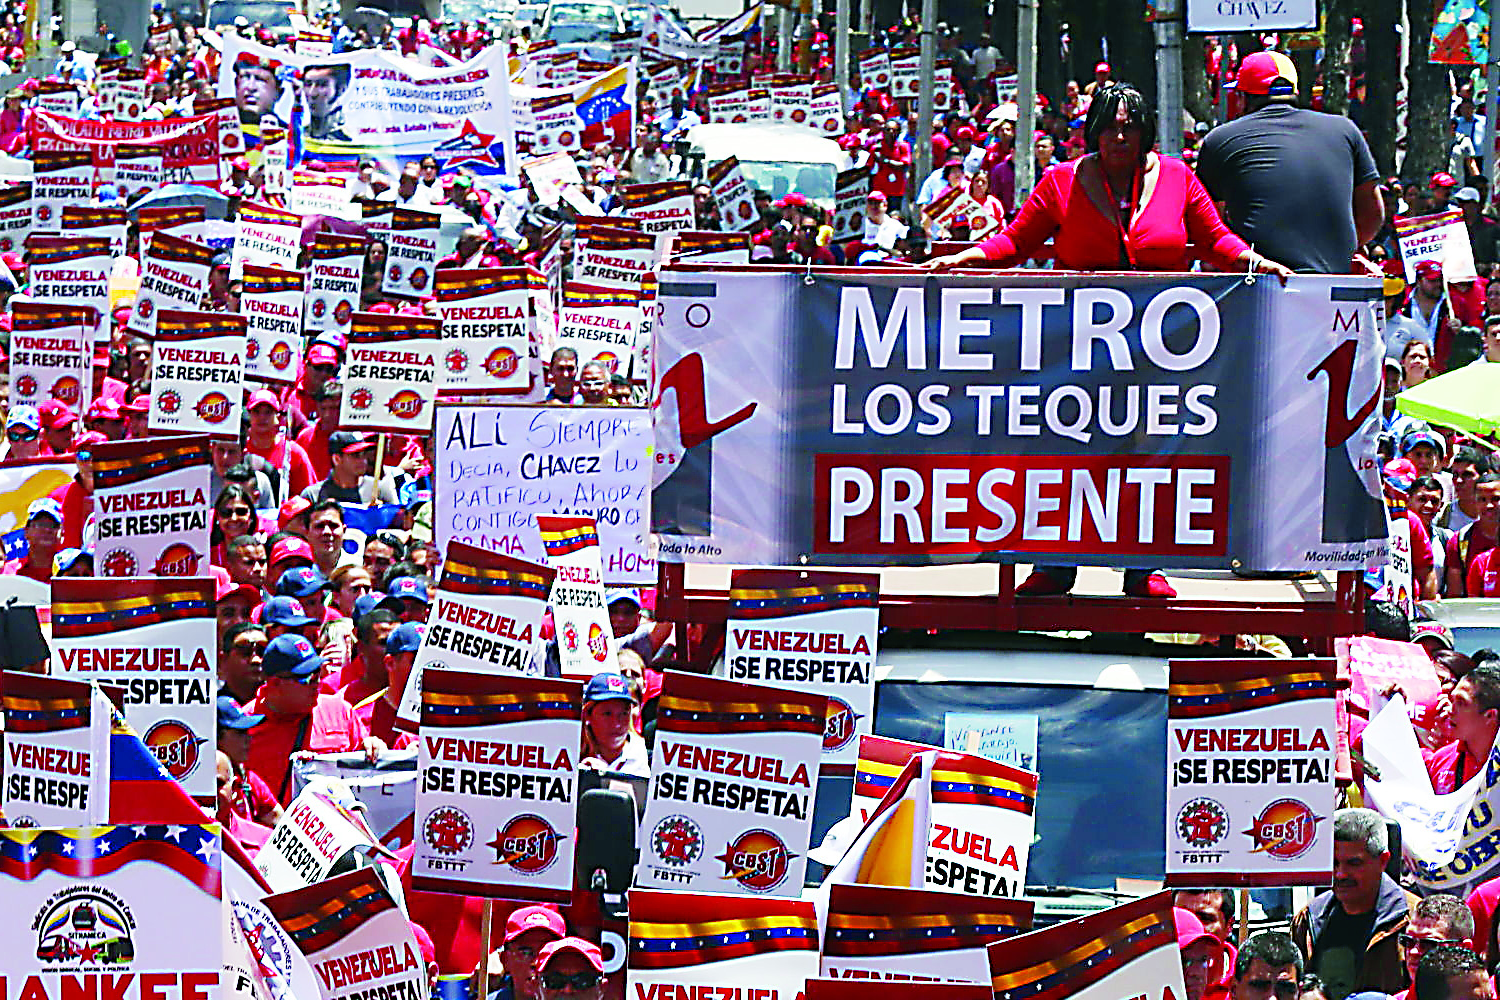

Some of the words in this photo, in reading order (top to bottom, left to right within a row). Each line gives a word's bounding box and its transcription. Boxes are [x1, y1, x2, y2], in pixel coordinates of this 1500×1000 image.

[38, 176, 90, 186] VENEZUELA
[392, 234, 436, 249] VENEZUELA
[314, 265, 360, 279] VENEZUELA
[587, 253, 647, 271] VENEZUELA
[34, 269, 108, 282] VENEZUELA
[147, 263, 202, 290] VENEZUELA
[52, 285, 107, 297] RESPETA!
[244, 299, 300, 319] VENEZUELA
[440, 306, 525, 321] VENEZUELA
[257, 316, 297, 334] RESPETA!
[564, 313, 632, 331] VENEZUELA
[835, 286, 1220, 371] METRO
[13, 336, 91, 354] VENEZUELA
[159, 347, 241, 365] VENEZUELA
[350, 349, 435, 367] VENEZUELA
[156, 366, 180, 379] ¡SE
[186, 366, 241, 384] RESPETA!
[833, 383, 952, 435] LOS
[967, 384, 1217, 441] TEQUES
[521, 453, 600, 480] CHAVEZ
[98, 487, 207, 514] VENEZUELA
[829, 467, 1216, 545] PRESENTE
[98, 515, 130, 539] ¡SE
[132, 509, 207, 535] RESPETA!
[697, 545, 722, 556] Alto
[1304, 549, 1362, 562] Movilidad
[437, 601, 533, 645] VENEZUELA
[426, 626, 454, 649] ¡SE
[456, 630, 529, 671] RESPETA!
[732, 629, 870, 655] VENEZUELA
[57, 647, 209, 672] VENEZUELA
[123, 678, 211, 705] ESPETA!
[1175, 728, 1329, 753] VENEZUELA
[424, 737, 571, 772] VENEZUELA
[661, 741, 809, 787] VENEZUELA
[421, 768, 456, 796] ¡SE
[459, 769, 573, 803] RESPETA!
[1173, 758, 1208, 788] ¡SE
[1212, 758, 1330, 784] RESPETA!
[653, 774, 690, 803] ¡SE
[692, 775, 809, 821] RESPETA!
[291, 799, 341, 862] VENEZUELA
[1261, 810, 1311, 845] CBST
[504, 825, 557, 873] CBST
[1182, 850, 1222, 864] FBTTT
[427, 857, 466, 872] FBTTT
[313, 942, 418, 991] VENEZUELA
